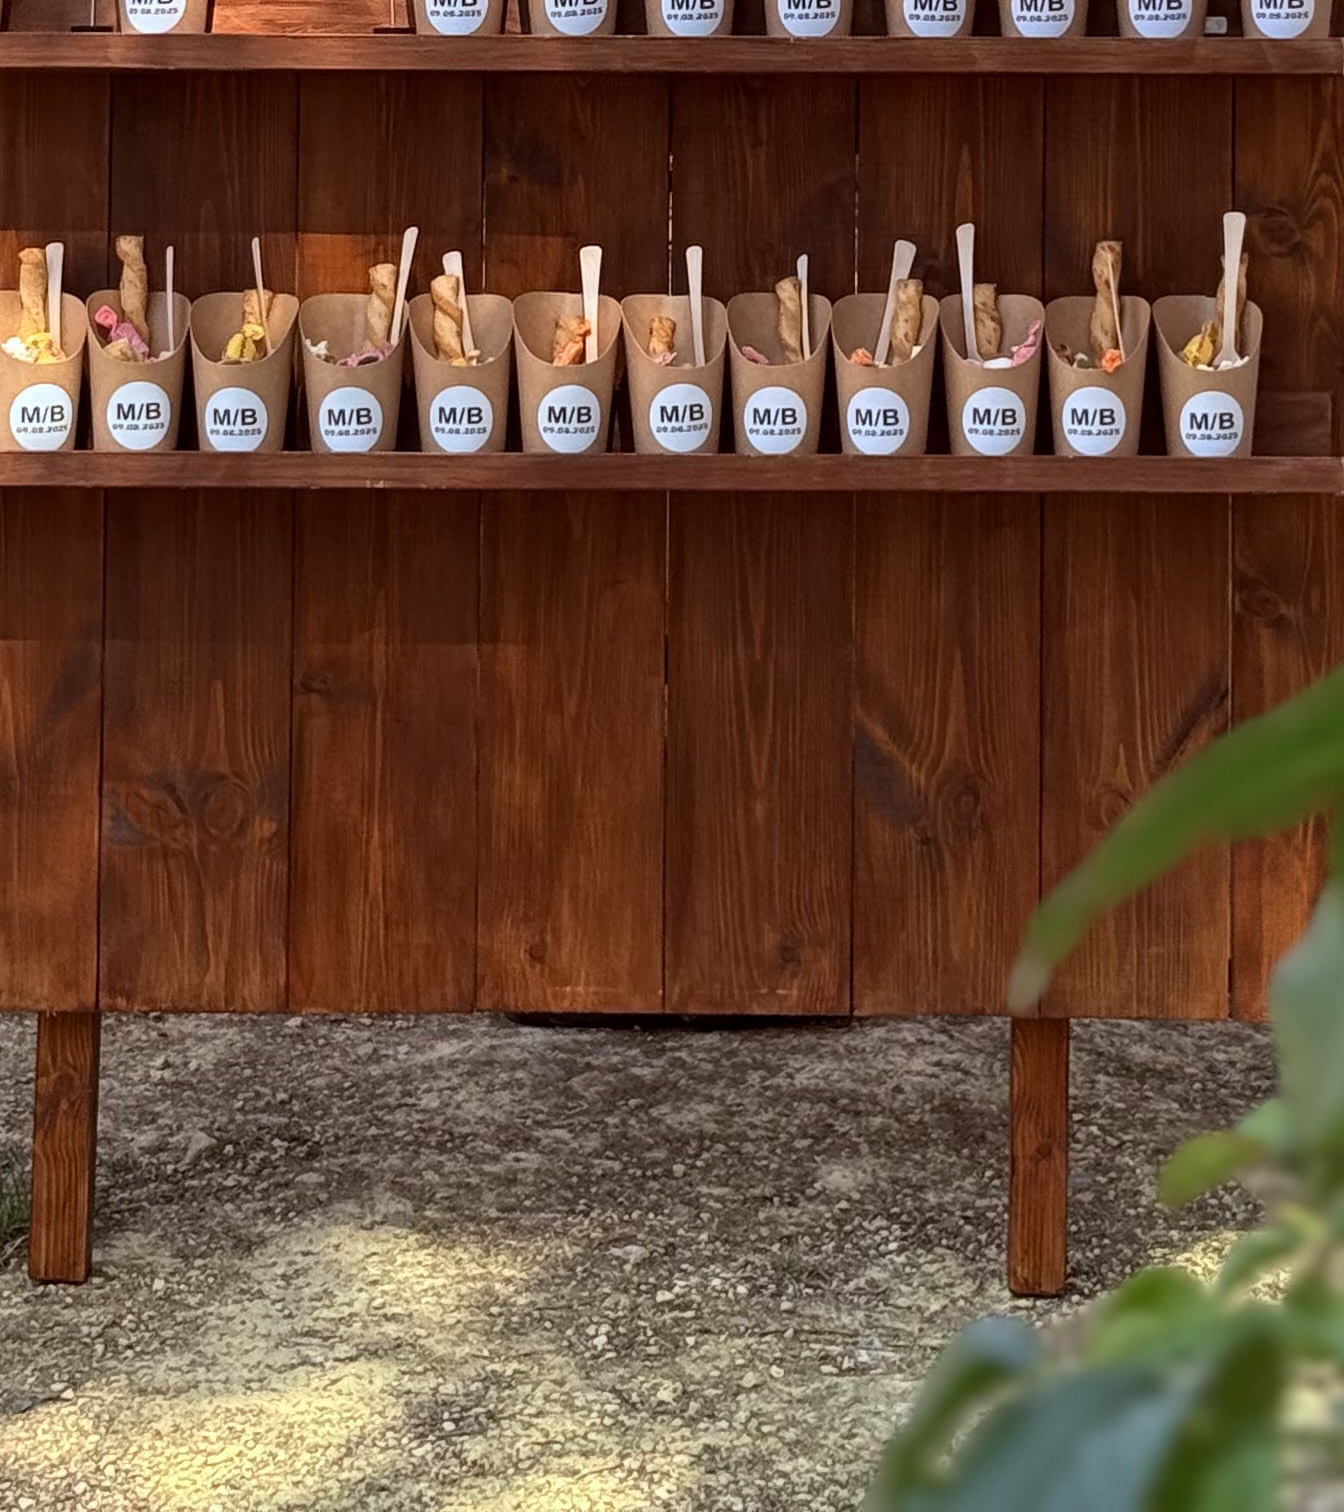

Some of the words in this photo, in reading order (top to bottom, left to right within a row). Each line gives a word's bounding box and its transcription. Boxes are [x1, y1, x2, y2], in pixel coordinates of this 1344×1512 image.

[21, 404, 65, 424] M/B
[117, 401, 161, 421] M/B
[213, 407, 258, 427] M/B
[327, 407, 373, 427] M/B
[438, 406, 484, 426] M/B
[547, 405, 593, 425] M/B
[659, 403, 705, 424] M/B
[752, 407, 798, 427] M/B
[855, 408, 900, 428] M/B
[972, 407, 1018, 427] M/B
[1071, 407, 1117, 427] M/B
[1189, 412, 1236, 431] M/B
